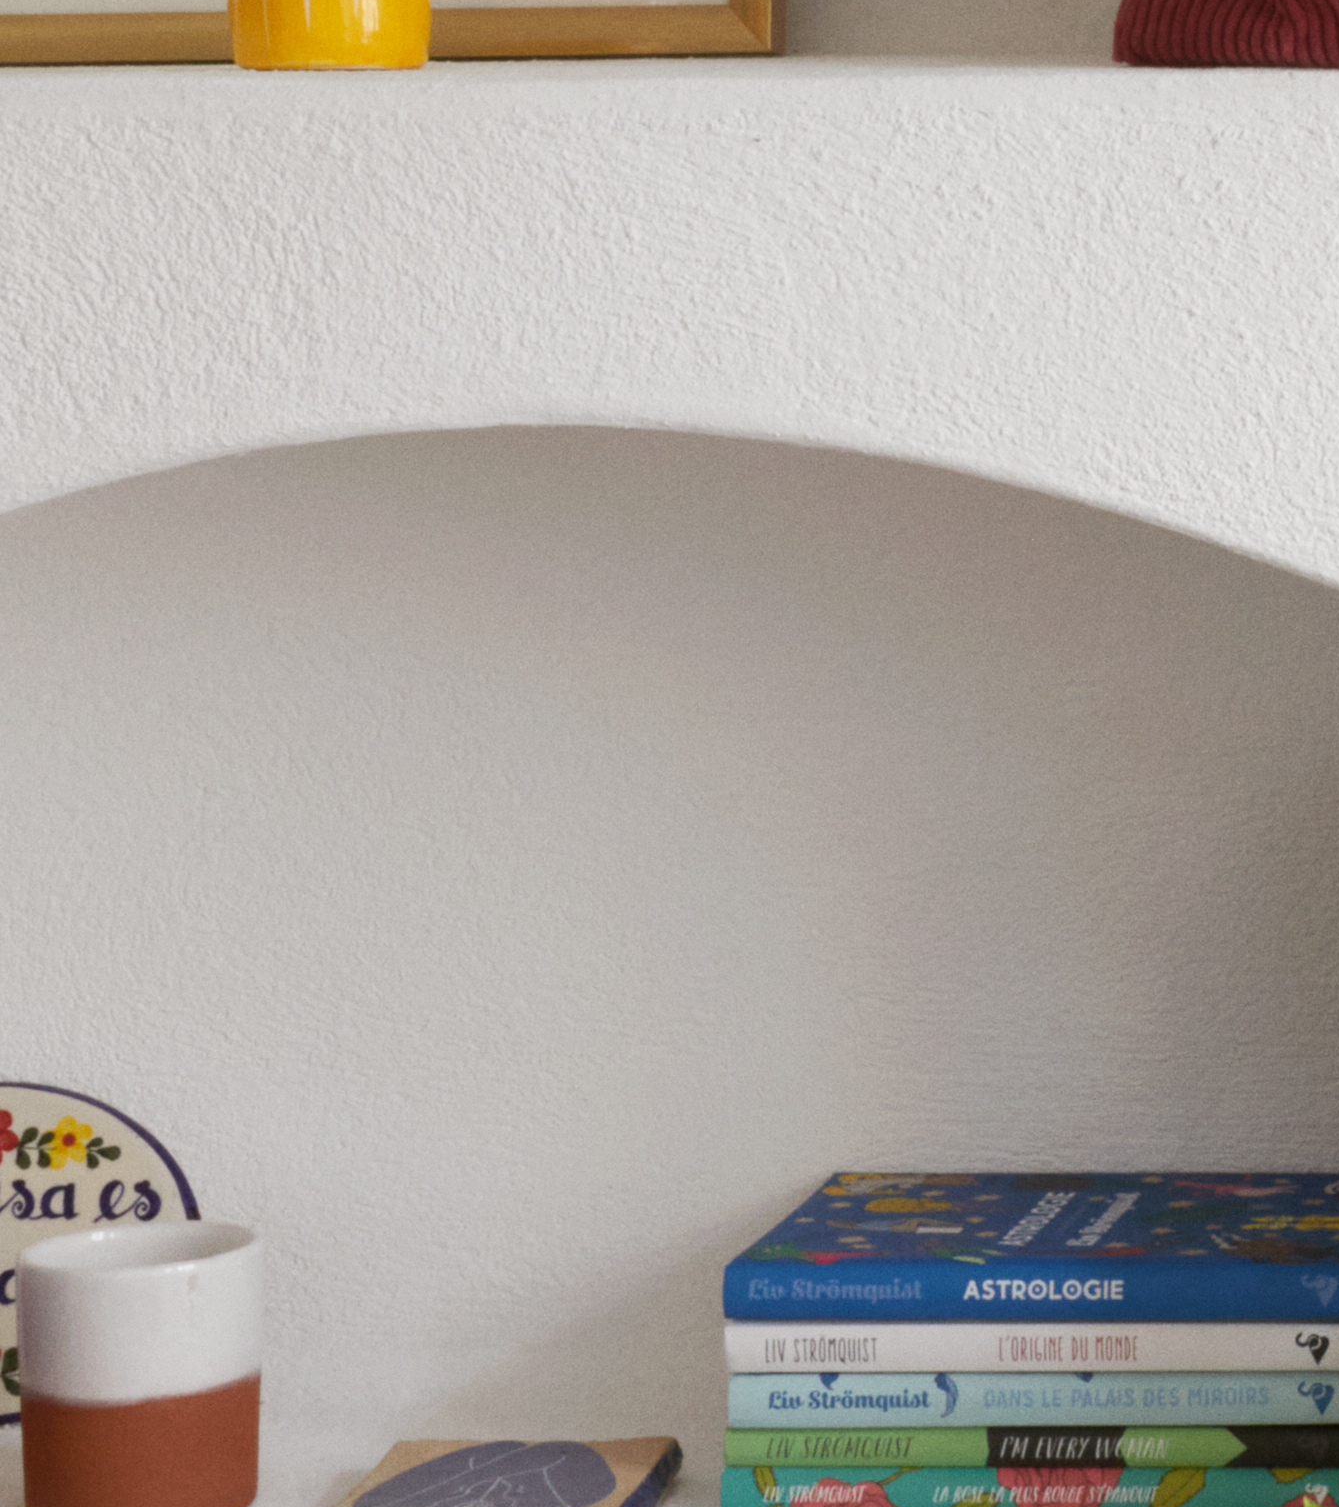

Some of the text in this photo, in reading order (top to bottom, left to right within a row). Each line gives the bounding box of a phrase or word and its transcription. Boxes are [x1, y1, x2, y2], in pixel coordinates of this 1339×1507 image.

[0, 1179, 161, 1223] sa es
[748, 1278, 1125, 1304] Liv Strömquist ASTROLOGIE
[765, 1335, 1137, 1363] LIV STRÖMQUIST L'ORIGINE DU MONDE
[768, 1387, 1269, 1412] Liv Strömquist DANS LE PALAIS DES MIROIRS
[766, 1436, 794, 1459] LIV
[1000, 1436, 1029, 1459] I'M
[1035, 1436, 1090, 1459] EVERY
[1095, 1436, 1169, 1459] WOMAN
[763, 1485, 787, 1503] LIV
[932, 1485, 949, 1503] LA
[952, 1485, 985, 1503] ROSE
[988, 1485, 1005, 1503] LA
[1009, 1485, 1040, 1503] PLUS
